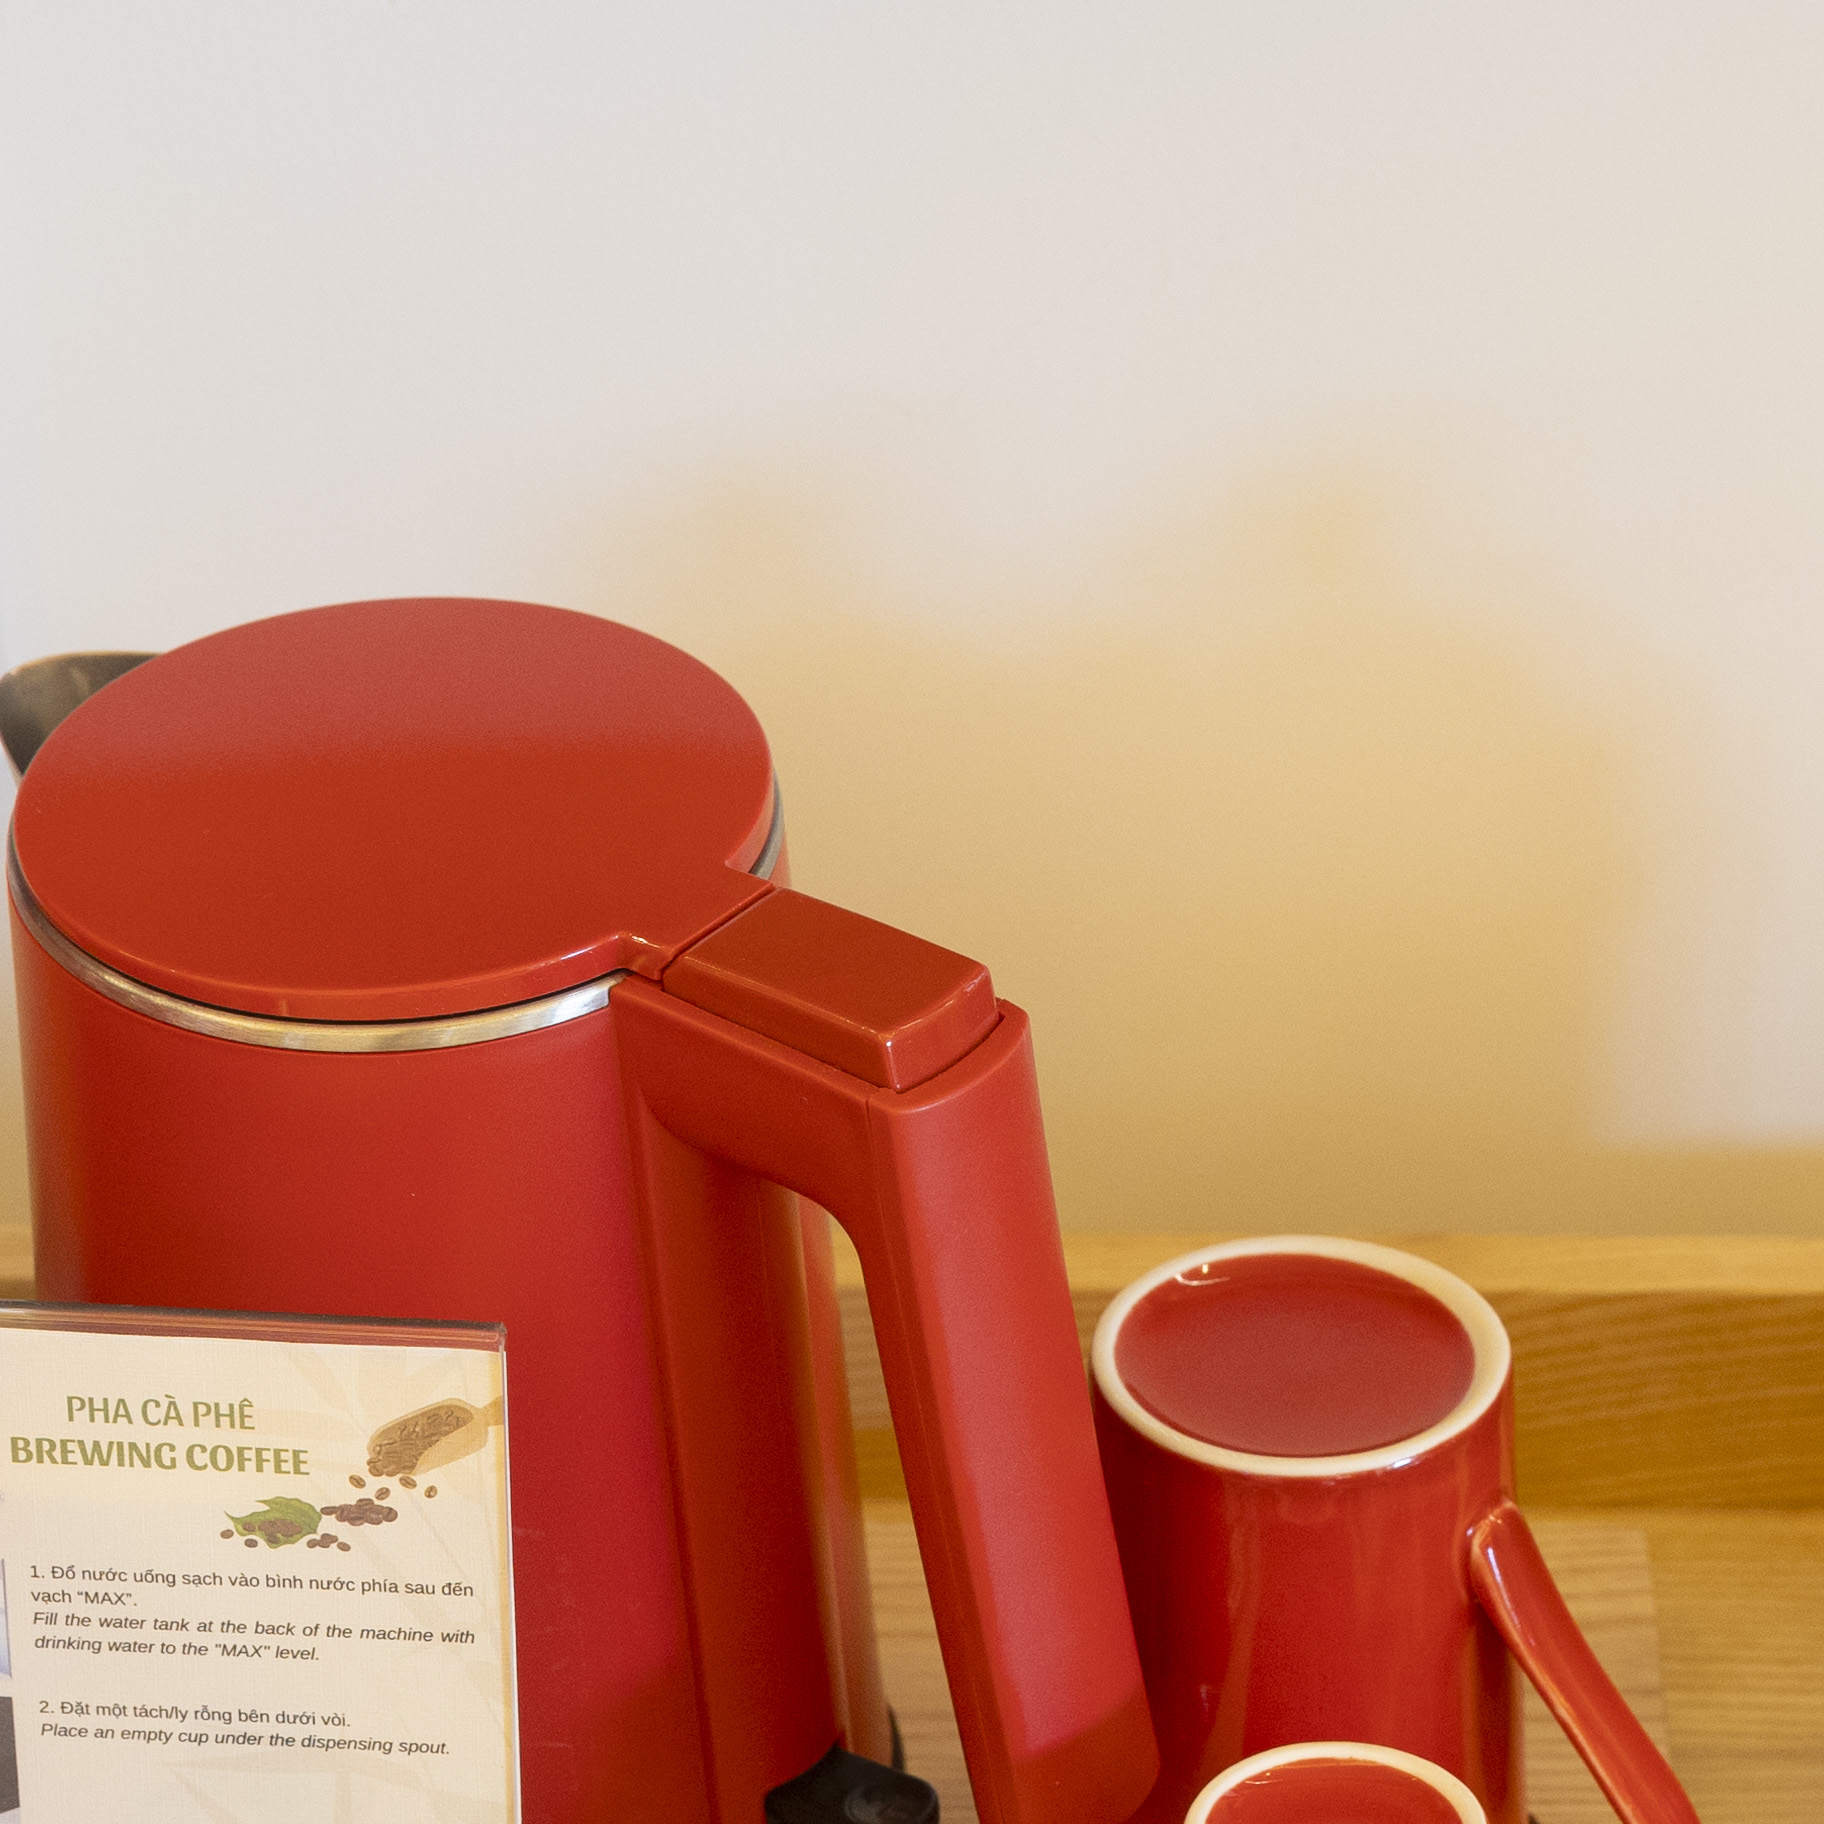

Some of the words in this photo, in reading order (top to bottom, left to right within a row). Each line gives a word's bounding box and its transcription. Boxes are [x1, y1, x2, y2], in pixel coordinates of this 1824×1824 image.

[67, 1396, 133, 1425] PHA
[141, 1394, 184, 1427] CÀ
[193, 1398, 255, 1430] PHÊ
[10, 1436, 177, 1469] BREWING
[186, 1443, 309, 1475] COFFEE
[30, 1565, 45, 1579] 1.
[82, 1568, 127, 1582] nước
[182, 1572, 222, 1587] sạch
[228, 1573, 259, 1587] vào
[266, 1575, 303, 1589] bình
[309, 1577, 355, 1591] nước
[361, 1579, 399, 1595] phía
[405, 1583, 435, 1595] sau
[442, 1582, 473, 1597] đến
[31, 1589, 71, 1604] vạch
[33, 1612, 58, 1625] Fill
[65, 1614, 91, 1627] the
[99, 1617, 146, 1629] water
[153, 1618, 189, 1631] tank
[197, 1620, 213, 1632] at
[220, 1620, 247, 1634] the
[255, 1621, 295, 1636] back
[302, 1623, 320, 1637] of
[326, 1624, 352, 1638] the
[360, 1627, 433, 1641] machine
[441, 1630, 475, 1644] with
[35, 1636, 102, 1654] drinking
[108, 1640, 155, 1653] water
[161, 1642, 176, 1654] to
[182, 1642, 208, 1656] the
[275, 1646, 319, 1660] level.
[40, 1700, 54, 1714] 2.
[96, 1703, 128, 1719] một
[133, 1705, 188, 1722] tách/ly
[238, 1709, 269, 1723] bên
[276, 1711, 315, 1725] dưới
[321, 1713, 350, 1727] vòi.
[41, 1723, 88, 1737] Place
[94, 1728, 114, 1739] an
[121, 1728, 173, 1744] empty
[178, 1731, 209, 1745] cup
[215, 1731, 264, 1745] under
[269, 1733, 295, 1746] the
[301, 1735, 393, 1754] dispensing
[398, 1741, 449, 1755] spout.
